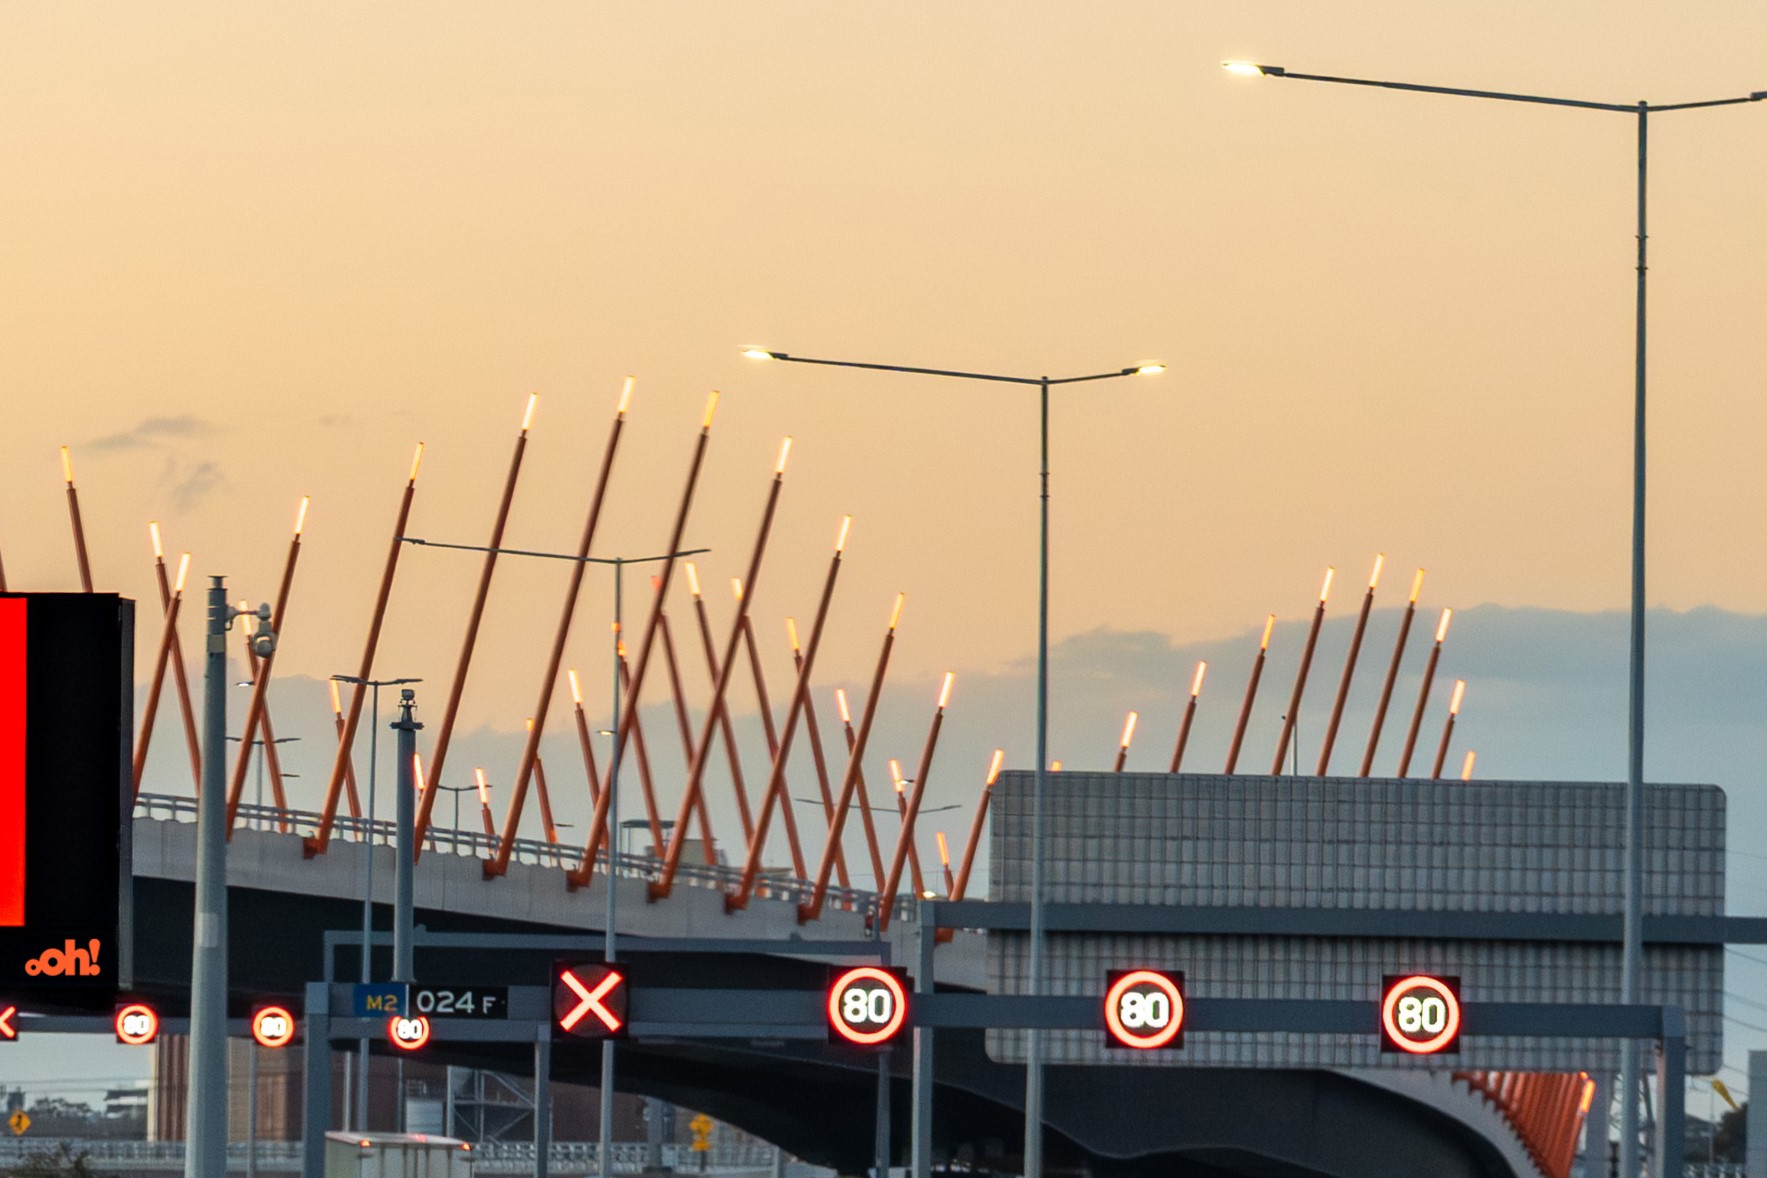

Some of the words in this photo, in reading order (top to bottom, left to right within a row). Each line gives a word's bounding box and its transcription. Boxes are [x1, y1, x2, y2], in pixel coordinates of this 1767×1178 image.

[366, 995, 398, 1012] M2
[416, 991, 476, 1013] 024
[483, 997, 496, 1013] F
[843, 988, 892, 1023] 80
[1121, 992, 1169, 1028] 80
[123, 1014, 150, 1035] 80
[1398, 996, 1446, 1033] 80
[260, 1017, 287, 1038] 80
[397, 1018, 423, 1039] 80
